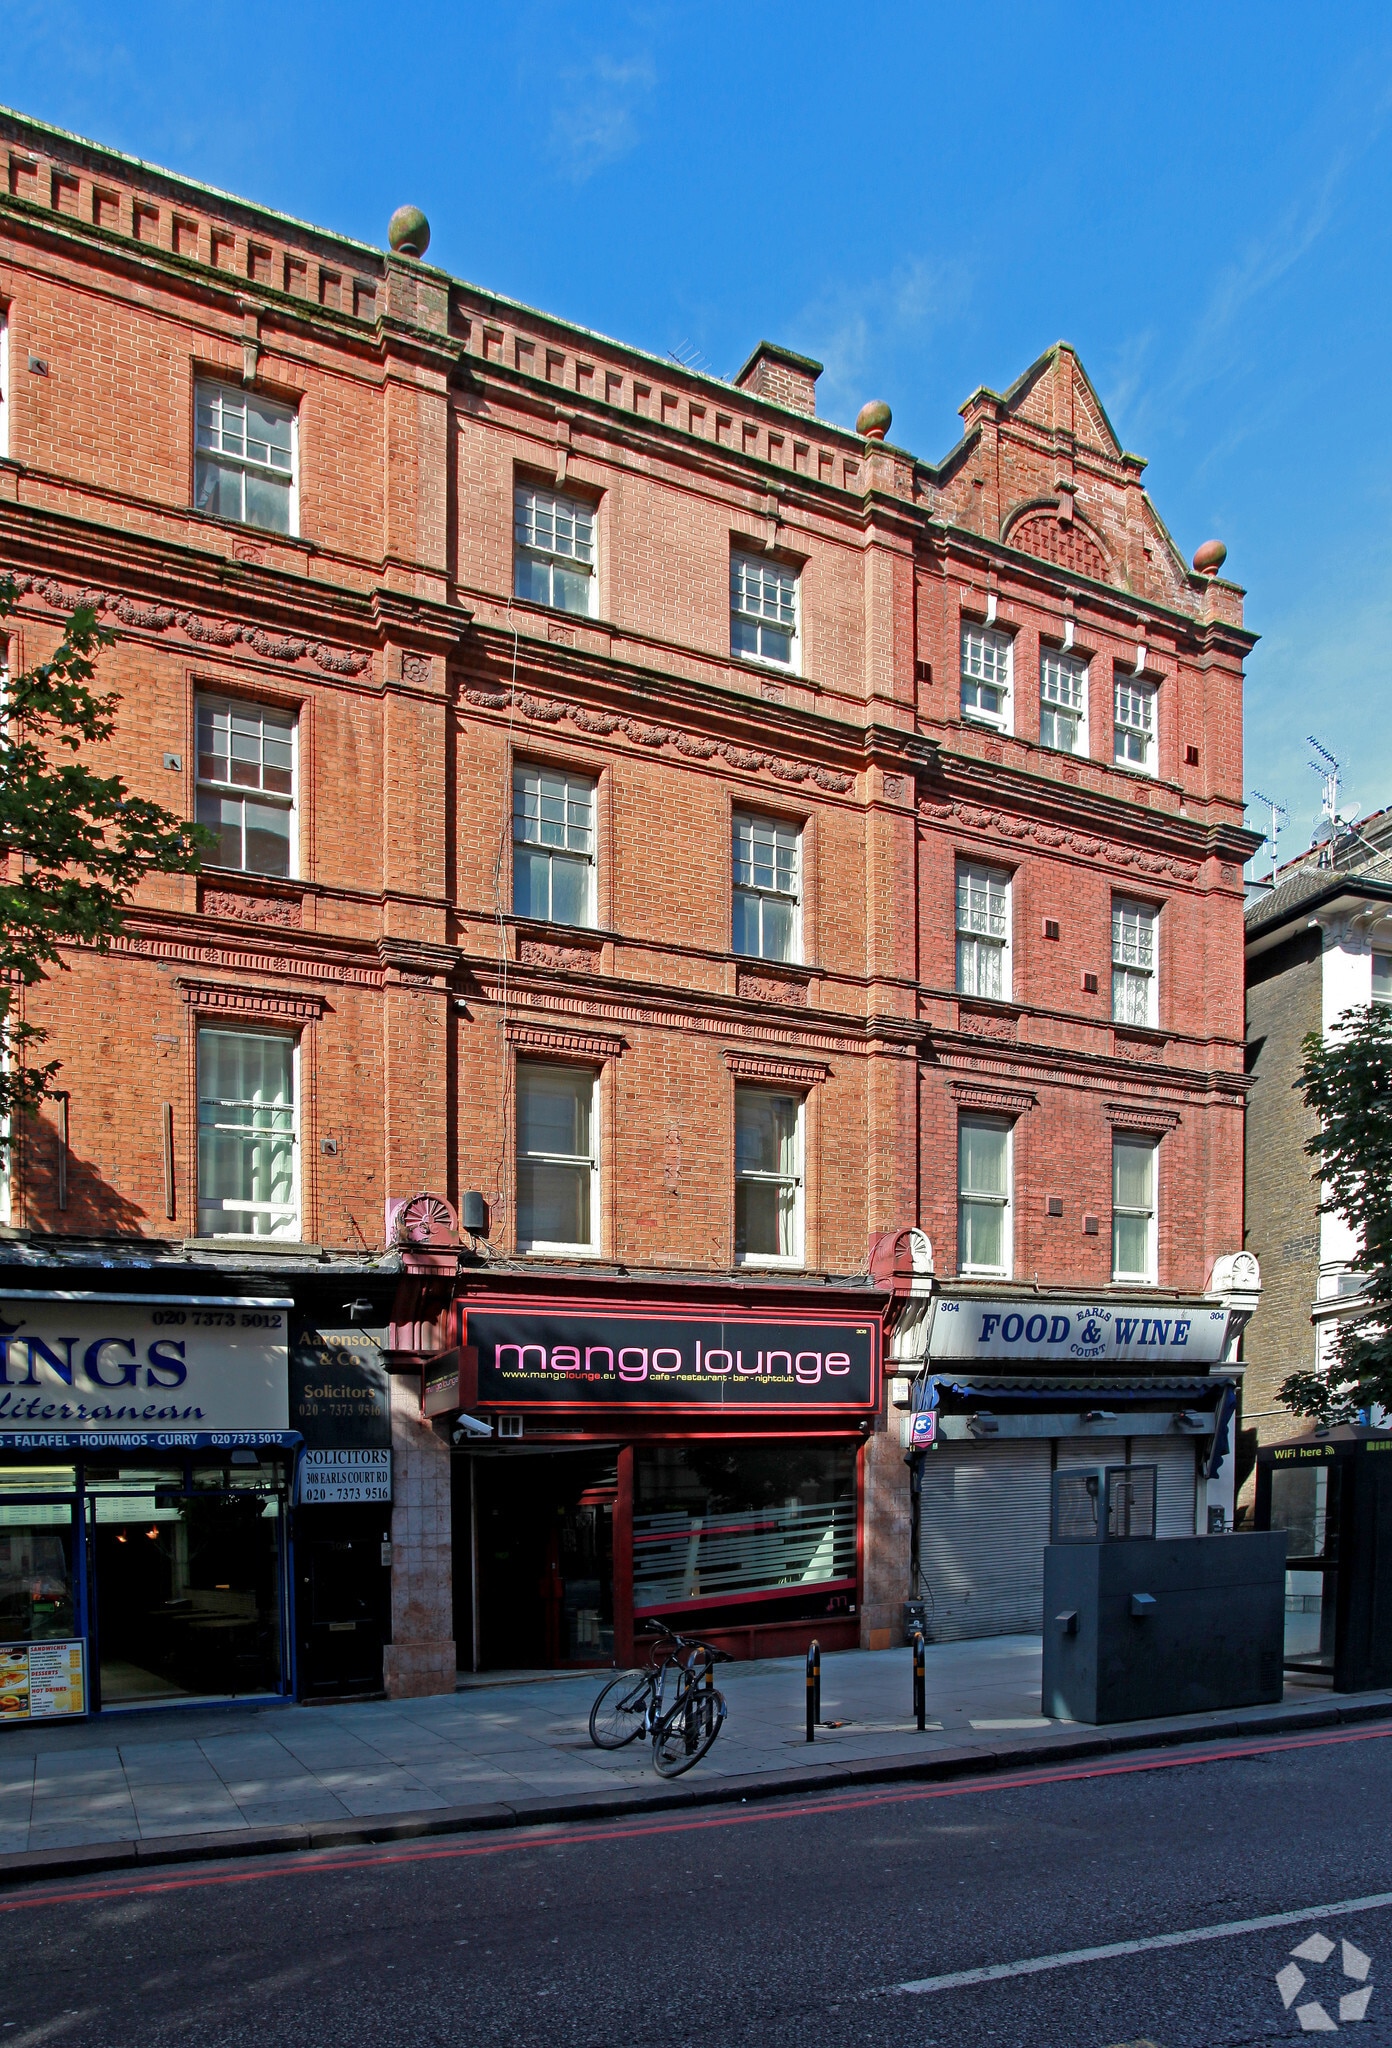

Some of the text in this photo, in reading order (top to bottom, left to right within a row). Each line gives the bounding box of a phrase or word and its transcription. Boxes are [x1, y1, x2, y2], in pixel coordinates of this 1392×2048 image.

[941, 1302, 960, 1312] 304
[152, 1310, 282, 1328] 020 7373 5012
[1076, 1307, 1112, 1322] EARLS
[1210, 1312, 1224, 1320] 304
[978, 1313, 1191, 1345] FOOD & WINE
[299, 1331, 381, 1347] Aaronson
[1070, 1343, 1106, 1358] COURT
[320, 1351, 360, 1366] & Co
[495, 1340, 850, 1384] mango lounge
[502, 1370, 616, 1381] www.mangolounge.eu
[676, 1374, 727, 1382] restaurant
[733, 1374, 749, 1382] bar
[755, 1375, 794, 1384] nightclub
[304, 1384, 375, 1398] Solicitors
[299, 1404, 319, 1416] 020
[329, 1404, 353, 1416] 7373
[358, 1404, 381, 1416] 9516
[15, 1435, 70, 1446] FALAFEL
[80, 1434, 148, 1446] HOUMMOS
[157, 1434, 198, 1445] CURRY
[211, 1434, 229, 1444] 020
[231, 1434, 256, 1444] 7373
[258, 1433, 283, 1444] 5012
[306, 1450, 388, 1464] SOLICITORS
[1274, 1447, 1322, 1459] WiFi here
[306, 1471, 388, 1484] 308 EARLS COURT RD
[306, 1489, 326, 1501] 020
[336, 1488, 361, 1500] 7373
[365, 1487, 388, 1499] 9516
